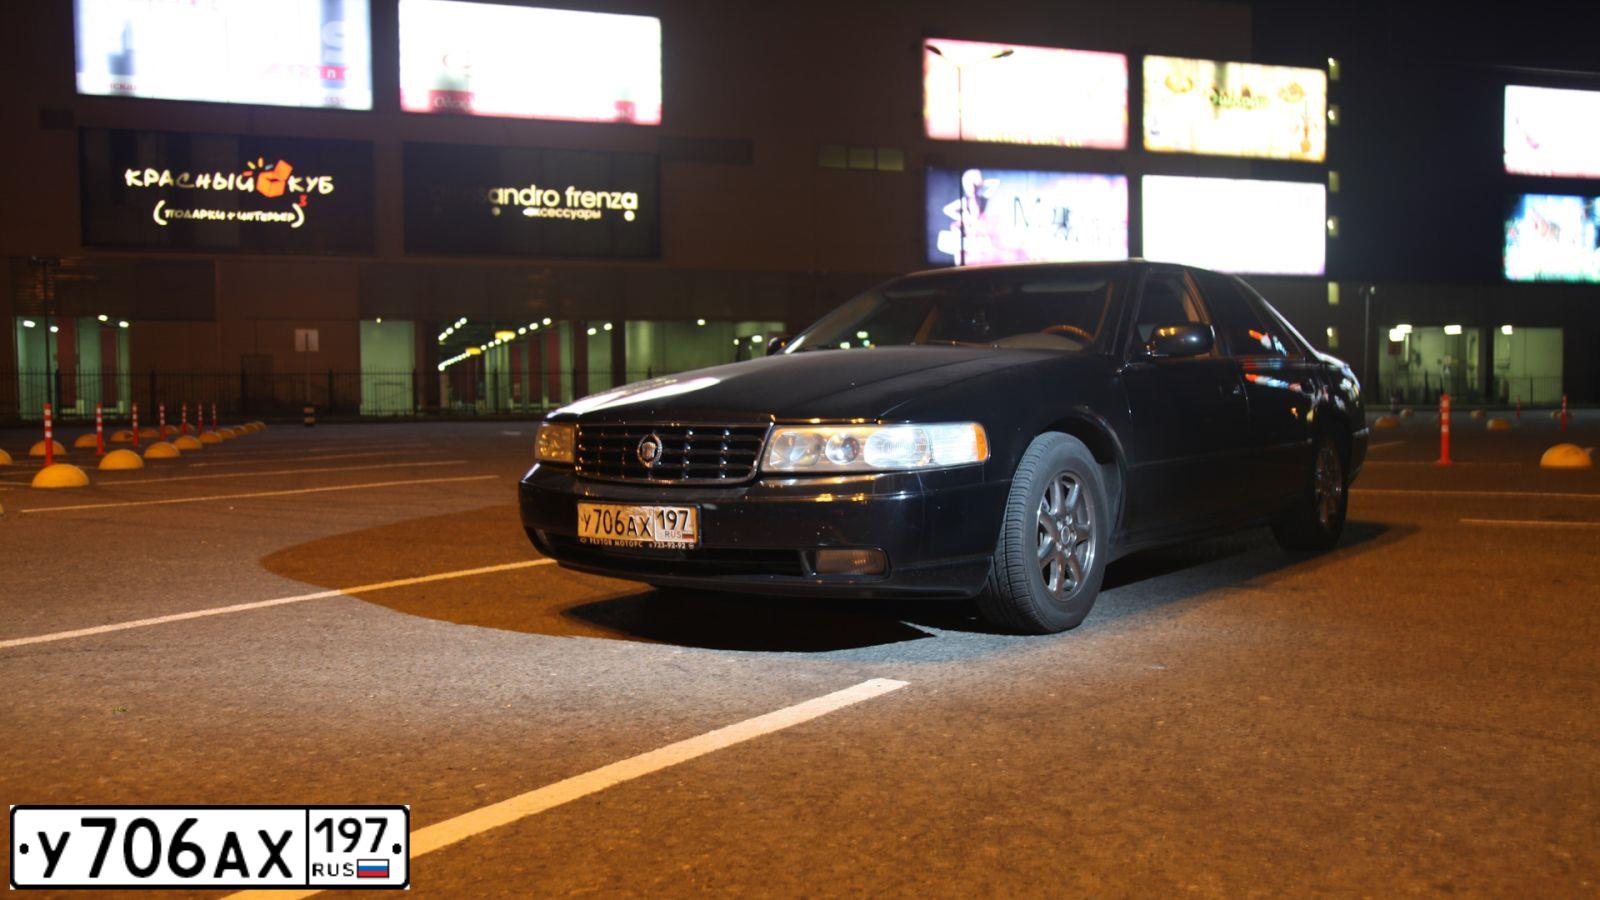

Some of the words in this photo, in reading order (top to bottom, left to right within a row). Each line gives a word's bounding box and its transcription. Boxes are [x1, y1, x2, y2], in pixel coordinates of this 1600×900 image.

[125, 168, 255, 193] КРАСНЫЙ
[287, 175, 335, 195] КУБ
[481, 184, 560, 208] andro
[565, 186, 639, 211] frenza
[522, 207, 602, 221] сессуары
[656, 509, 689, 531] 197
[664, 530, 682, 539] RUS
